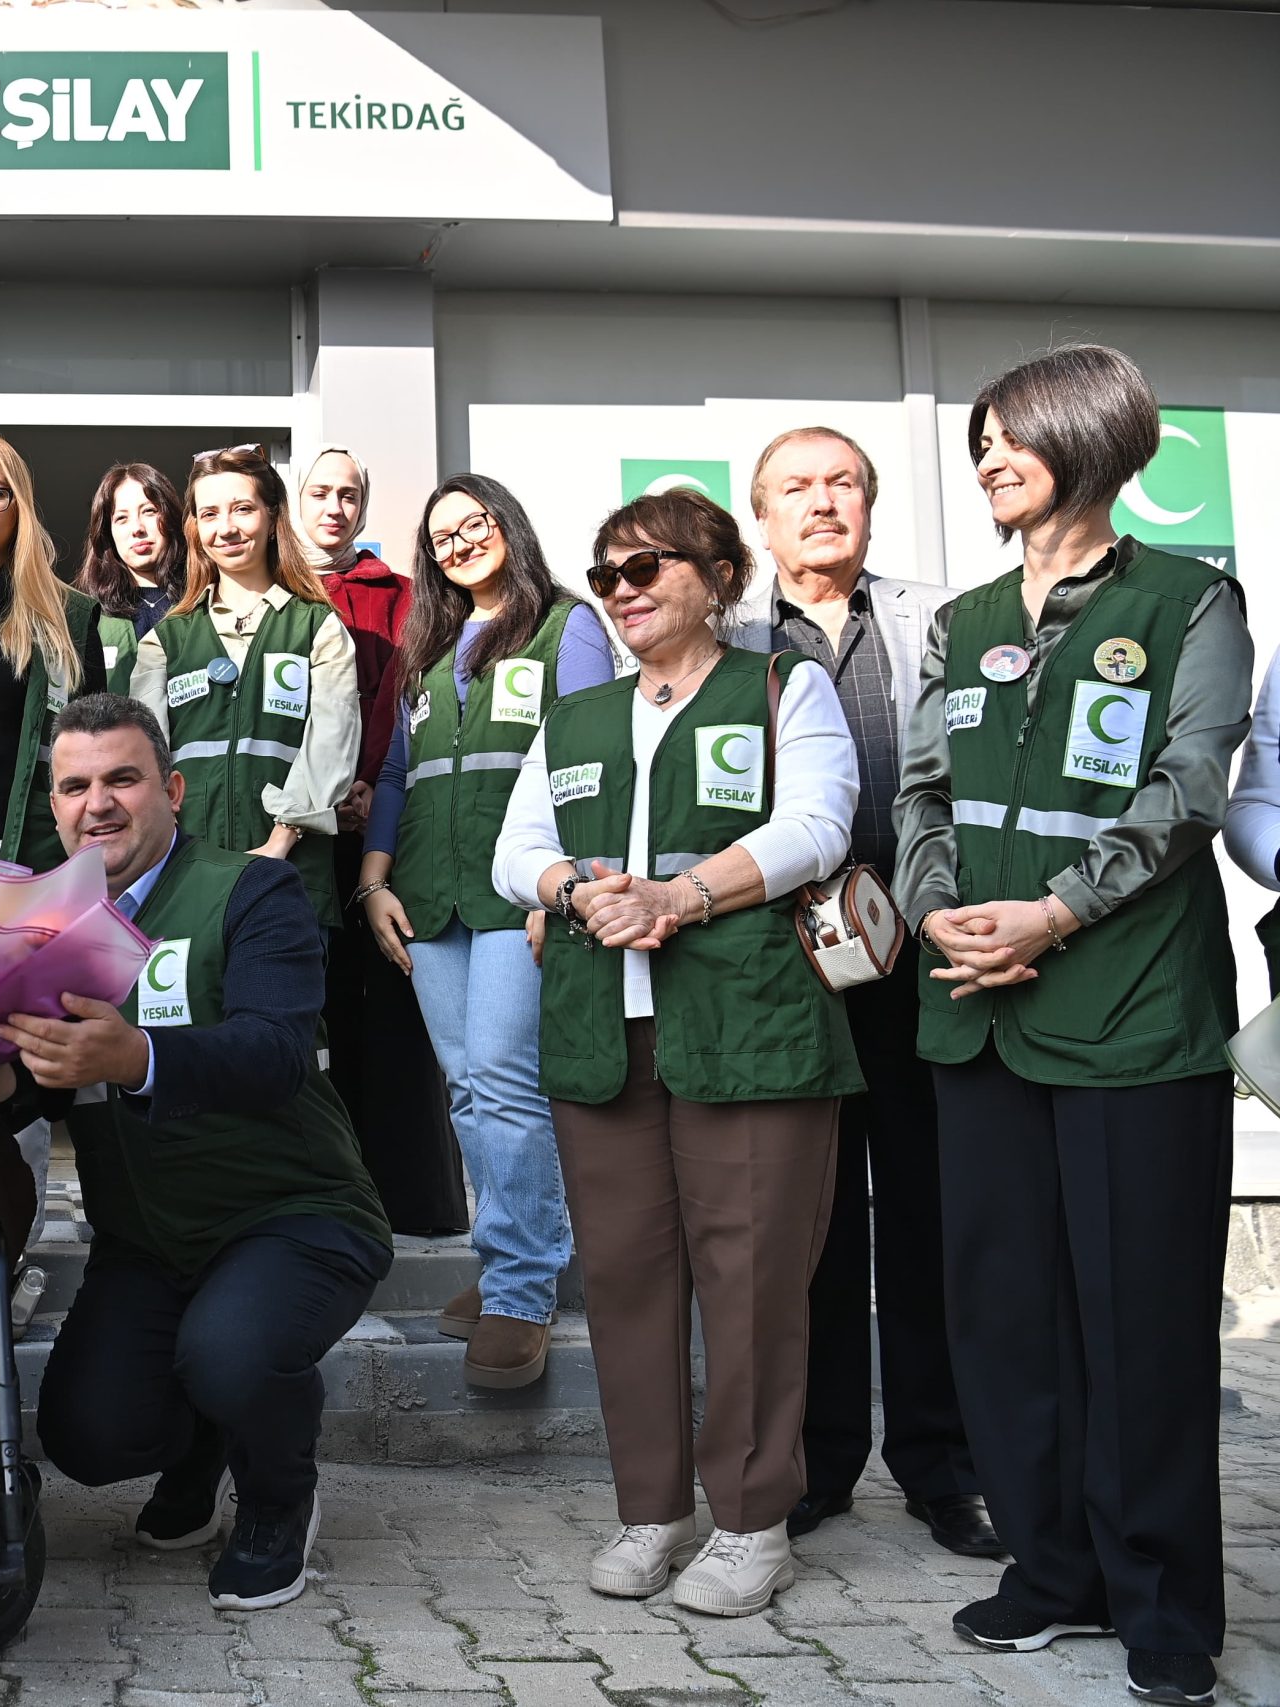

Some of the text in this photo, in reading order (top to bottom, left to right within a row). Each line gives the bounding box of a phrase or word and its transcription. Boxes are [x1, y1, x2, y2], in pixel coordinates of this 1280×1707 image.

[286, 94, 466, 131] TEKİRDAĞ
[1072, 754, 1133, 778] YEŞİLAY
[705, 787, 756, 804] YEŞİLAY
[142, 1004, 184, 1021] YEŞİLAY
